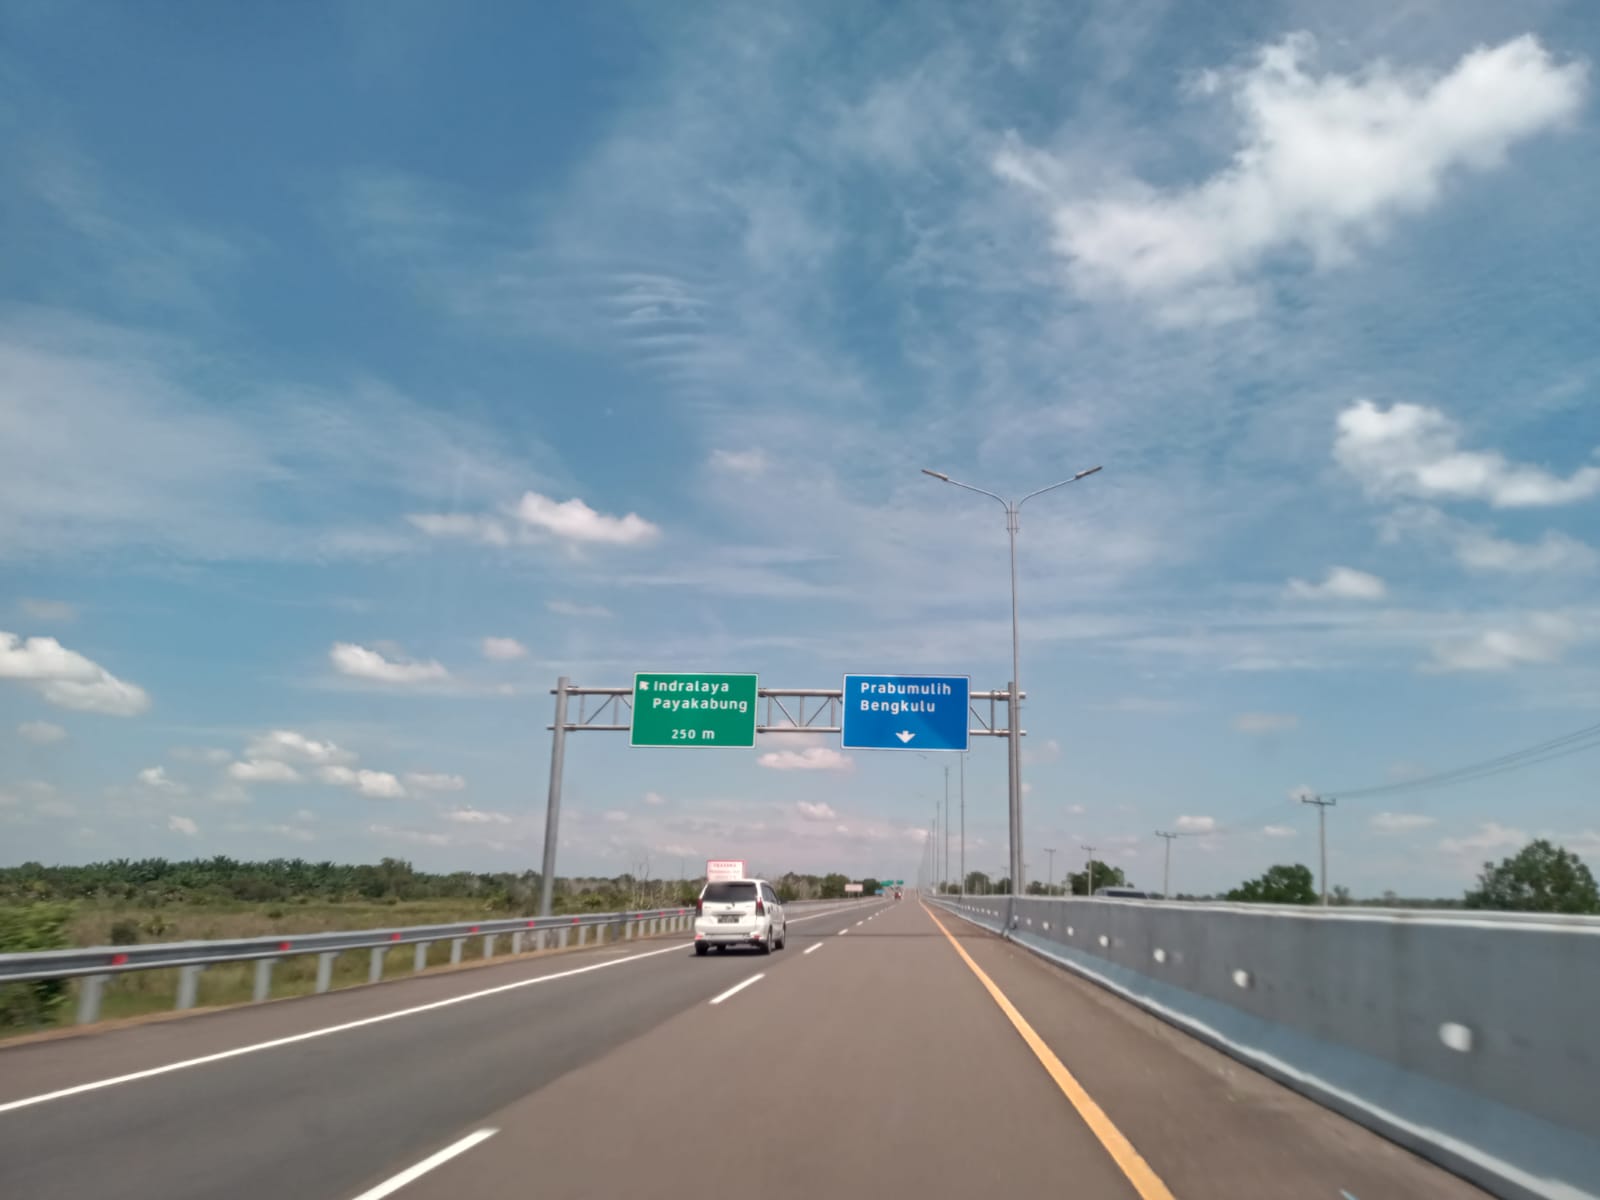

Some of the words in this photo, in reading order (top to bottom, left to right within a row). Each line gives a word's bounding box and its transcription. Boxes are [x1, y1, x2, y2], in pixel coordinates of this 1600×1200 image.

[654, 680, 729, 695] Indralaya
[861, 682, 951, 695] Prabumulih
[653, 697, 748, 713] Payakabung
[860, 699, 935, 715] Bengkulu
[671, 729, 696, 739] 250
[702, 730, 715, 739] m
